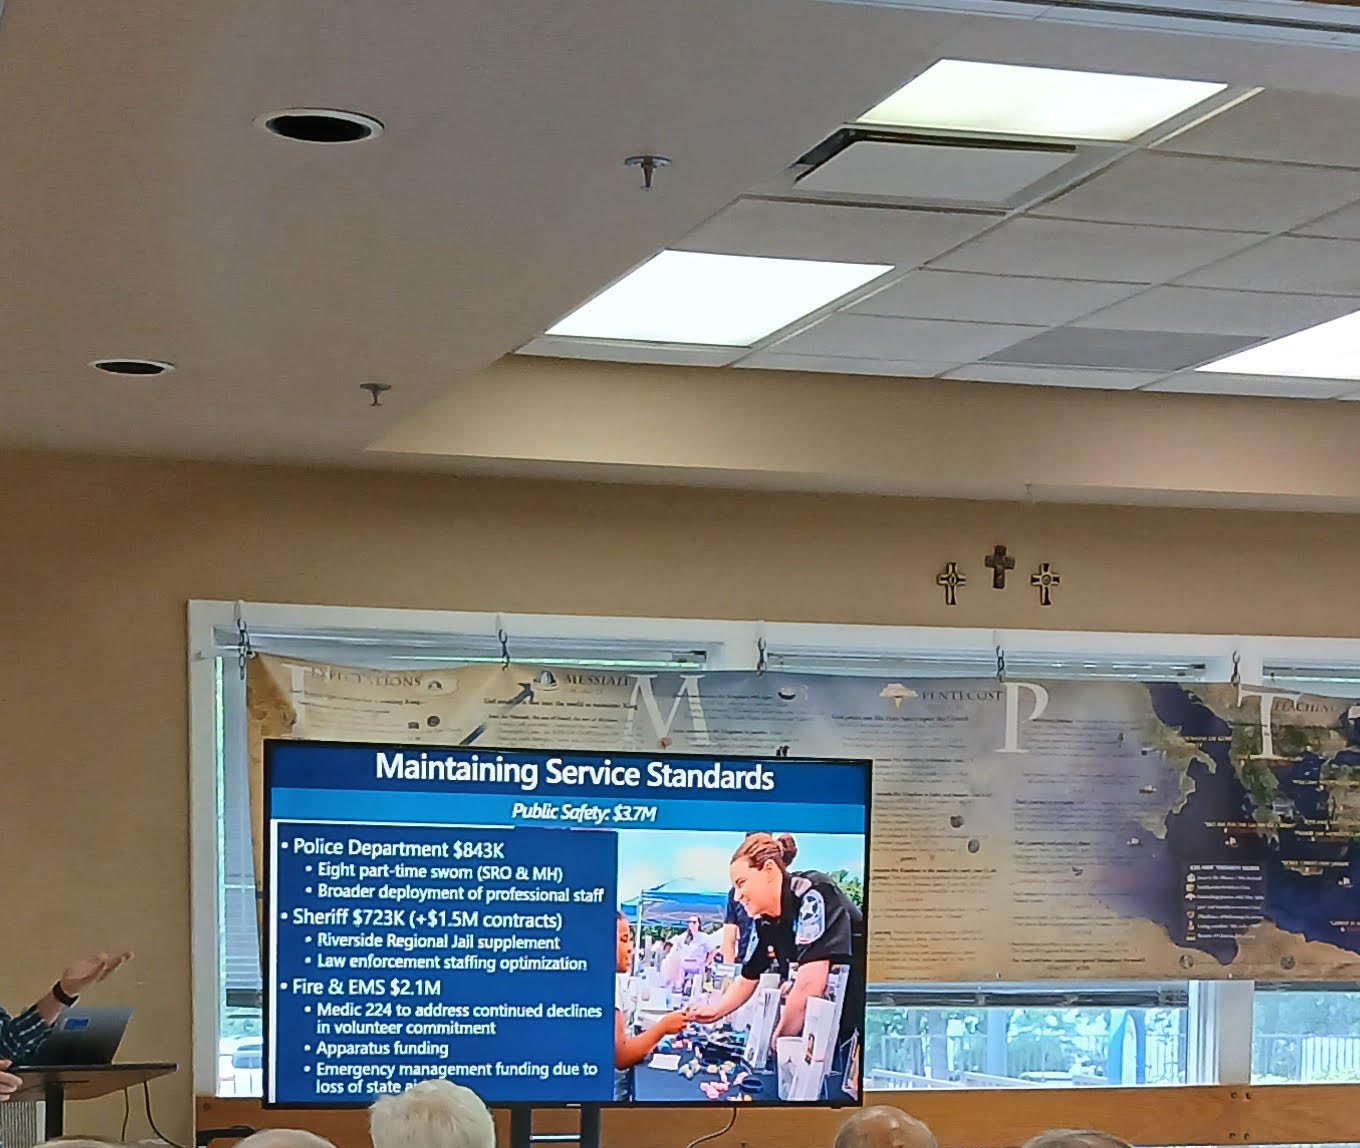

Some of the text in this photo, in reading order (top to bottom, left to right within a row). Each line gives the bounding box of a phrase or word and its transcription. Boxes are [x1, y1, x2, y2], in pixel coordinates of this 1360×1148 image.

[922, 689, 1004, 701] PENTECOST
[624, 673, 714, 746] M
[995, 682, 1049, 753] P
[1237, 684, 1304, 760] T
[375, 752, 775, 791] Maintaining Service Standards
[512, 802, 657, 825] Public Safety: $3.7M
[294, 838, 505, 860] Police Department $843K
[318, 862, 356, 880] Eight
[359, 864, 428, 880] part-time
[477, 865, 512, 882] (SRO
[516, 866, 530, 881] &
[532, 866, 564, 883] MH)
[318, 883, 605, 904] Broader deployment of professional staff
[293, 908, 563, 930] Sheriff $723K (+$1.5M contracts)
[318, 932, 561, 951] Riverside Regional Jail supplement
[318, 954, 588, 973] Law enforcement staffing optimization
[293, 978, 442, 997] Fire & EMS $2.1M
[317, 1003, 603, 1018] Medic 224 to address continued declines
[317, 1020, 497, 1035] in volunteer commitment
[316, 1042, 449, 1058] Apparatus funding
[316, 1062, 598, 1079] Emergency management funding due to
[316, 1079, 344, 1094] loss
[348, 1080, 364, 1094] of
[366, 1081, 401, 1094] state
